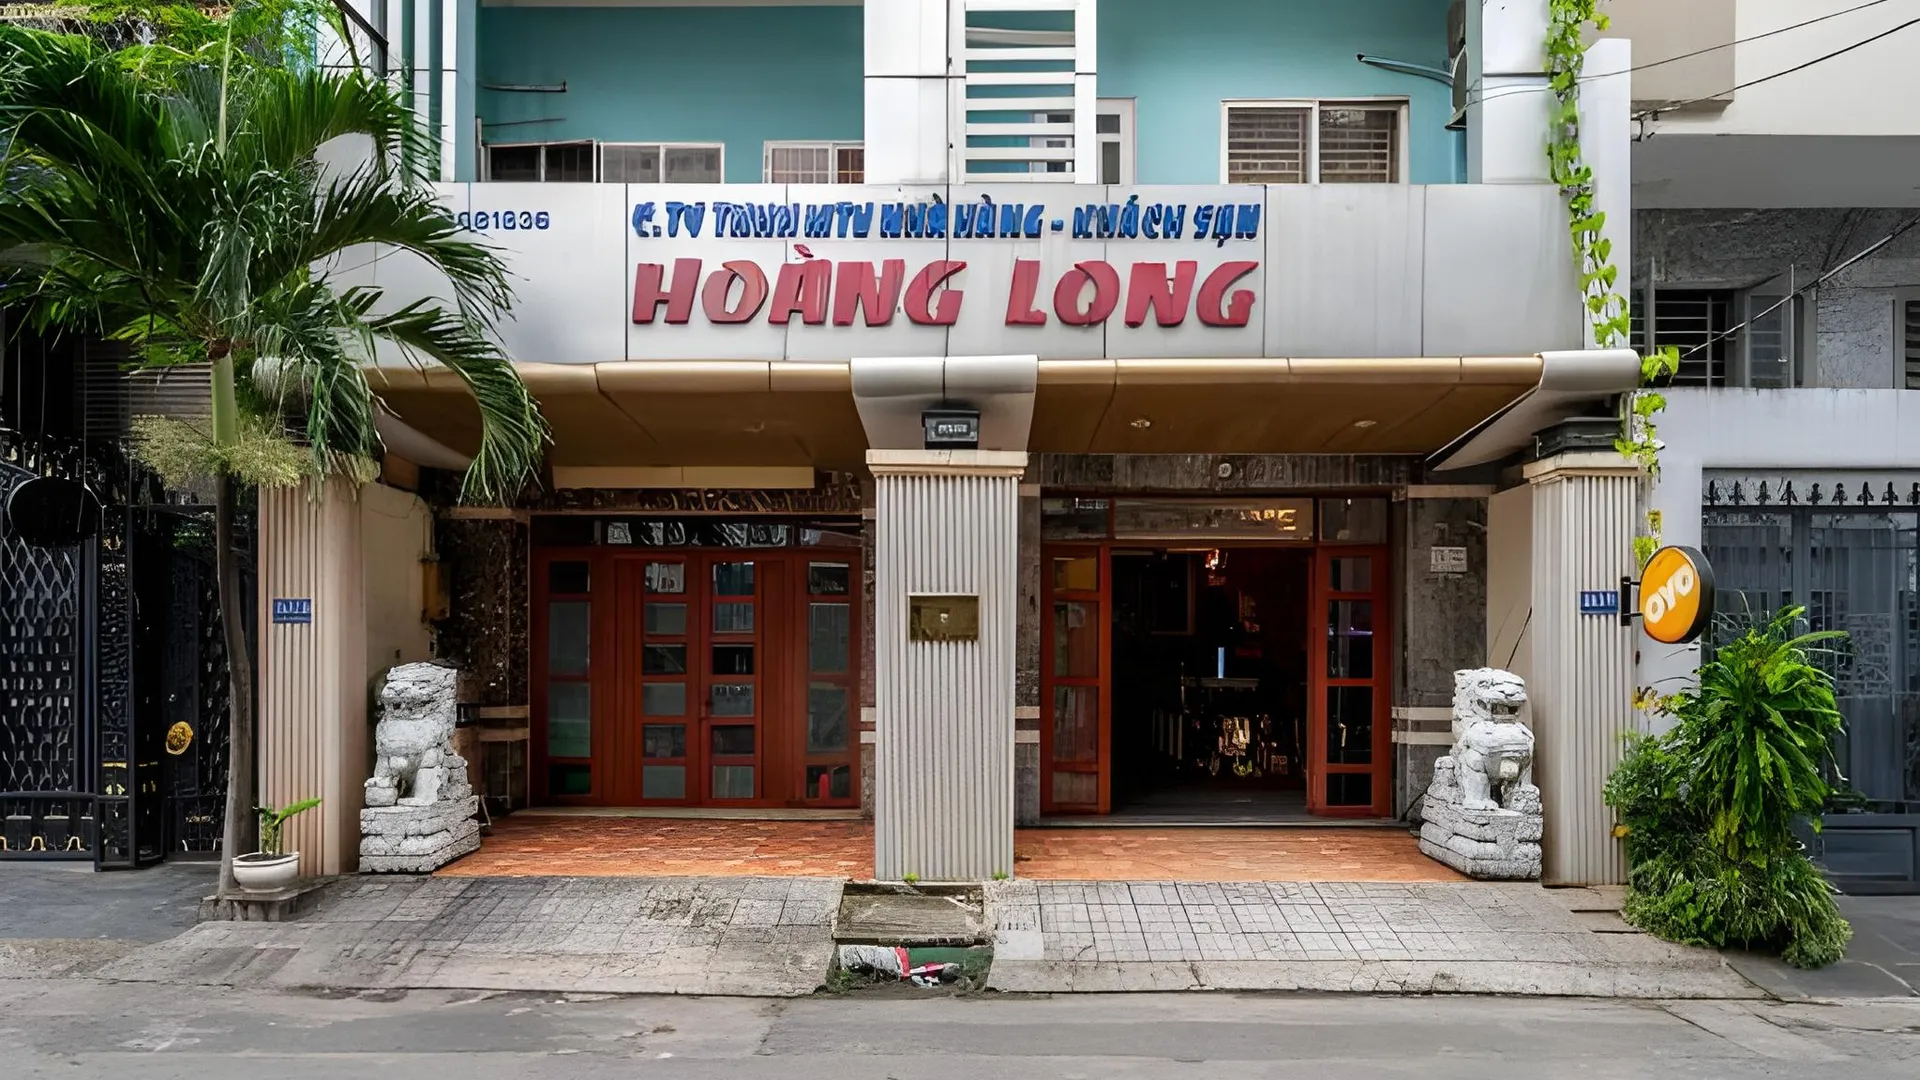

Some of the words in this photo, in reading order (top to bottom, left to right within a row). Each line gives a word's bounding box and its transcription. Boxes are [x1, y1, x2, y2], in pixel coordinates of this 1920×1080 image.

[632, 244, 967, 327] HOÀNG
[1005, 257, 1259, 328] LONG
[1645, 565, 1694, 623] OYO
